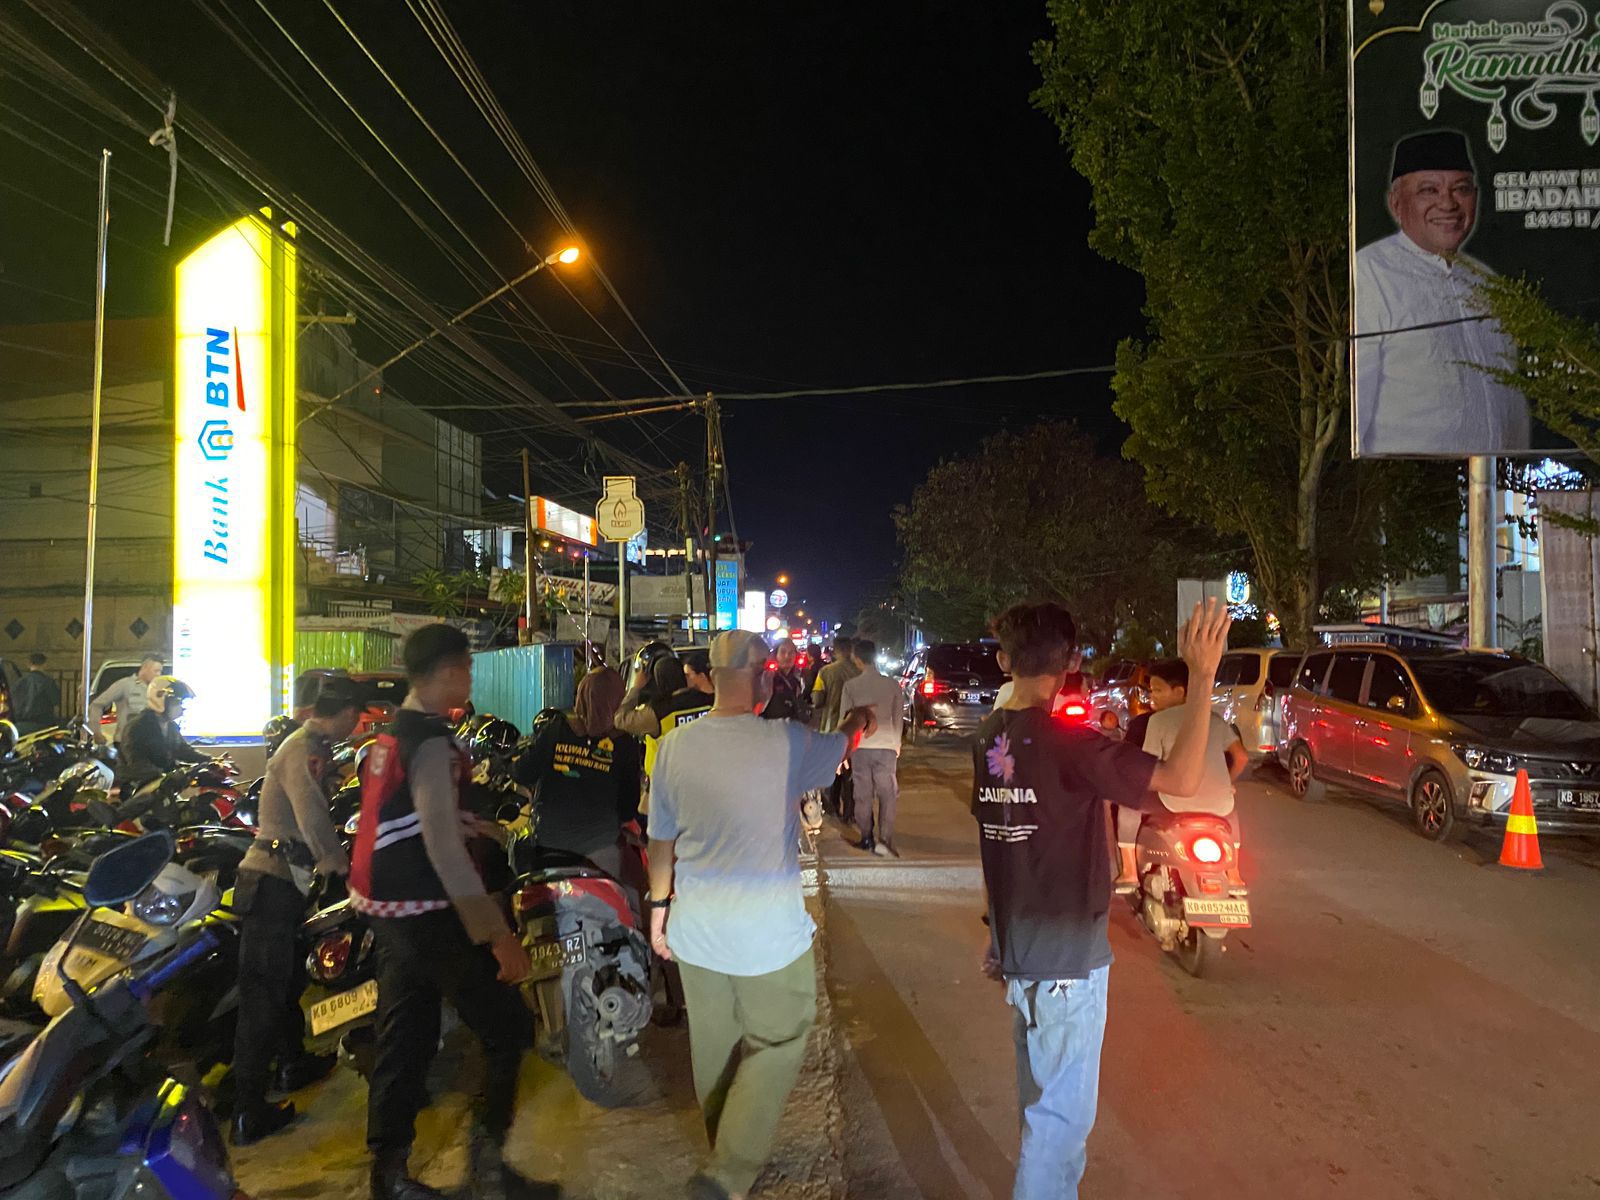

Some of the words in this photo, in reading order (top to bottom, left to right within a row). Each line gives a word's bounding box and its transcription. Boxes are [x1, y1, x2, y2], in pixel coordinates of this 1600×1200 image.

[1433, 20, 1525, 40] Marhaban
[1424, 39, 1600, 102] Ramadh
[1494, 170, 1580, 188] SELAMAT
[1495, 186, 1600, 212] IBADAH
[1525, 211, 1572, 229] 1445
[1574, 210, 1591, 227] H
[206, 327, 230, 408] BTN
[203, 477, 229, 564] Bank
[1561, 791, 1573, 803] KB
[566, 937, 580, 953] RZ
[313, 1003, 328, 1020] KB
